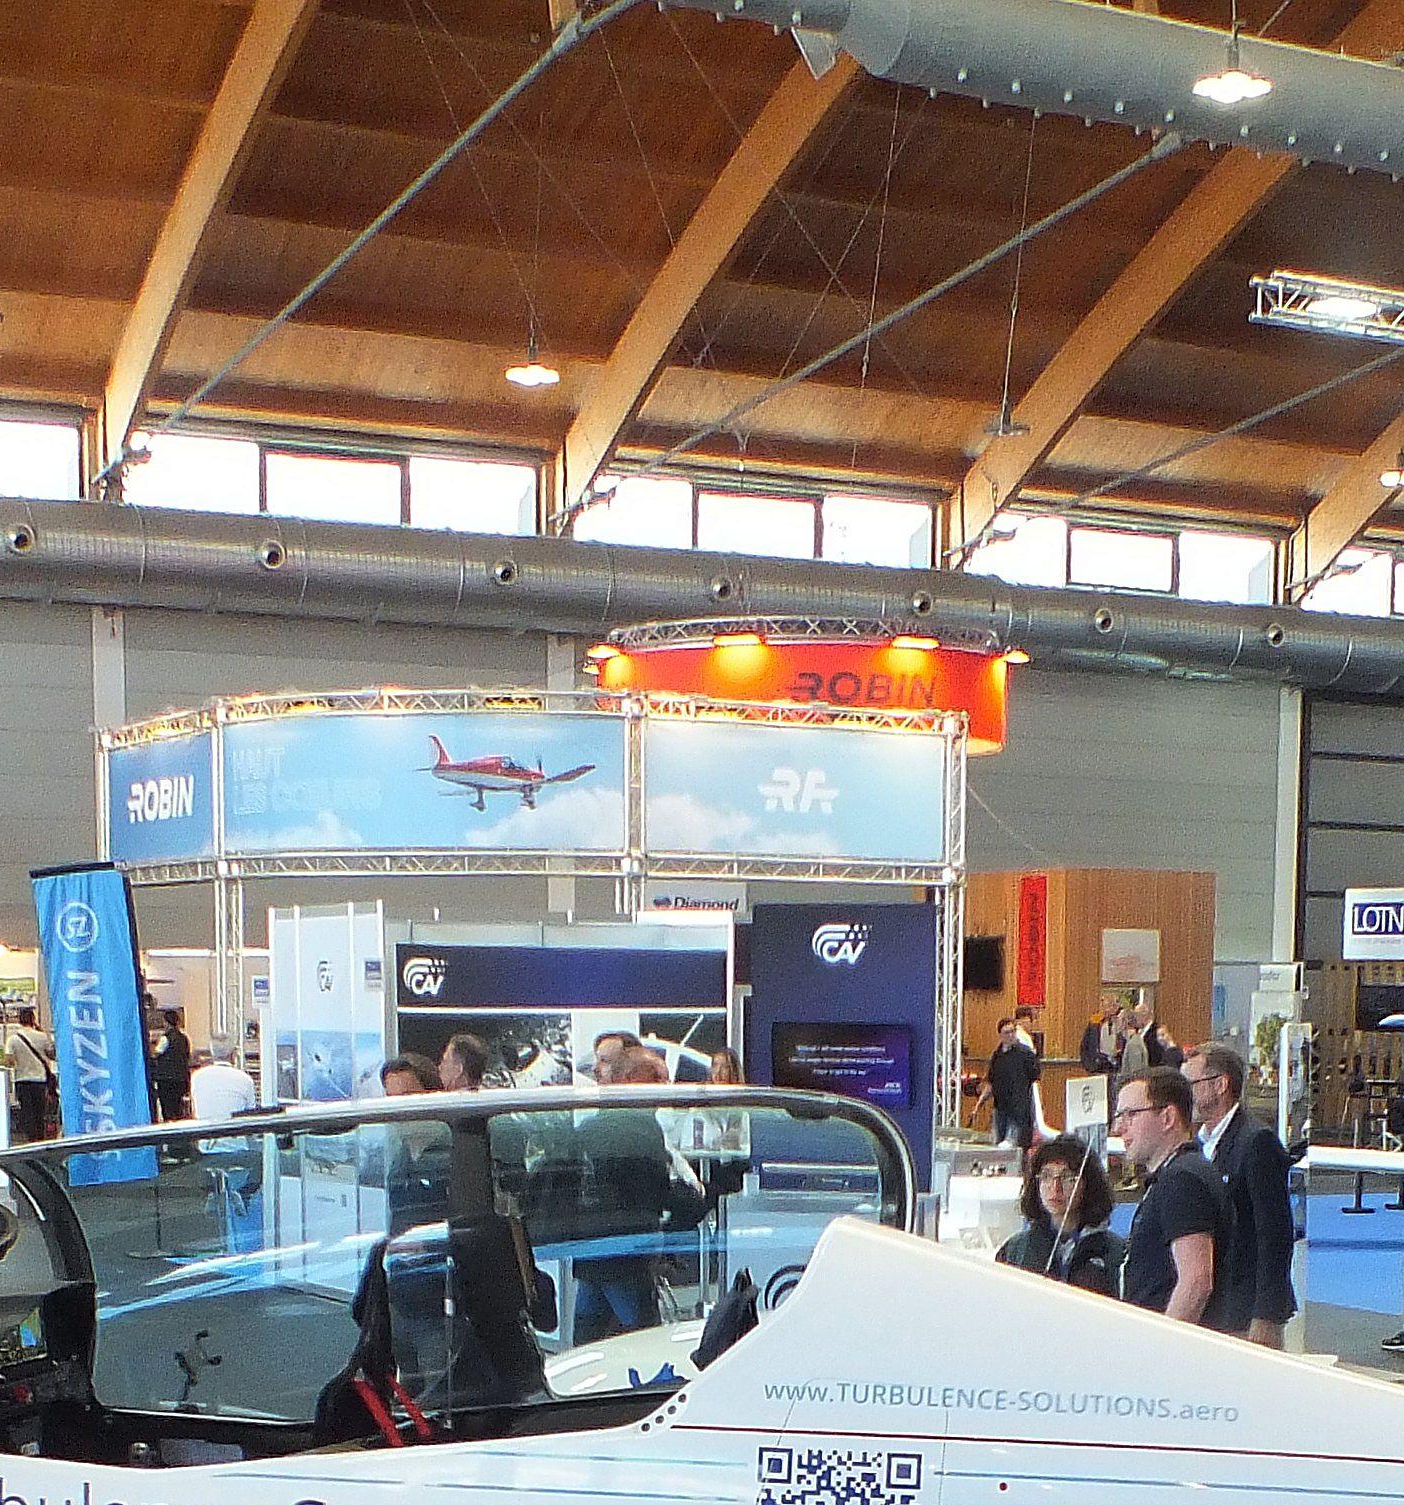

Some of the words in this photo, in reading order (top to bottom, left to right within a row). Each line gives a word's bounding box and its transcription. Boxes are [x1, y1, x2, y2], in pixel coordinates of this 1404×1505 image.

[787, 671, 937, 706] ROBIN
[127, 774, 194, 824] ROBIN
[674, 896, 740, 911] Diamond
[764, 1381, 1240, 1423] www.TURBULENCE-SOLUTIONS.aero
